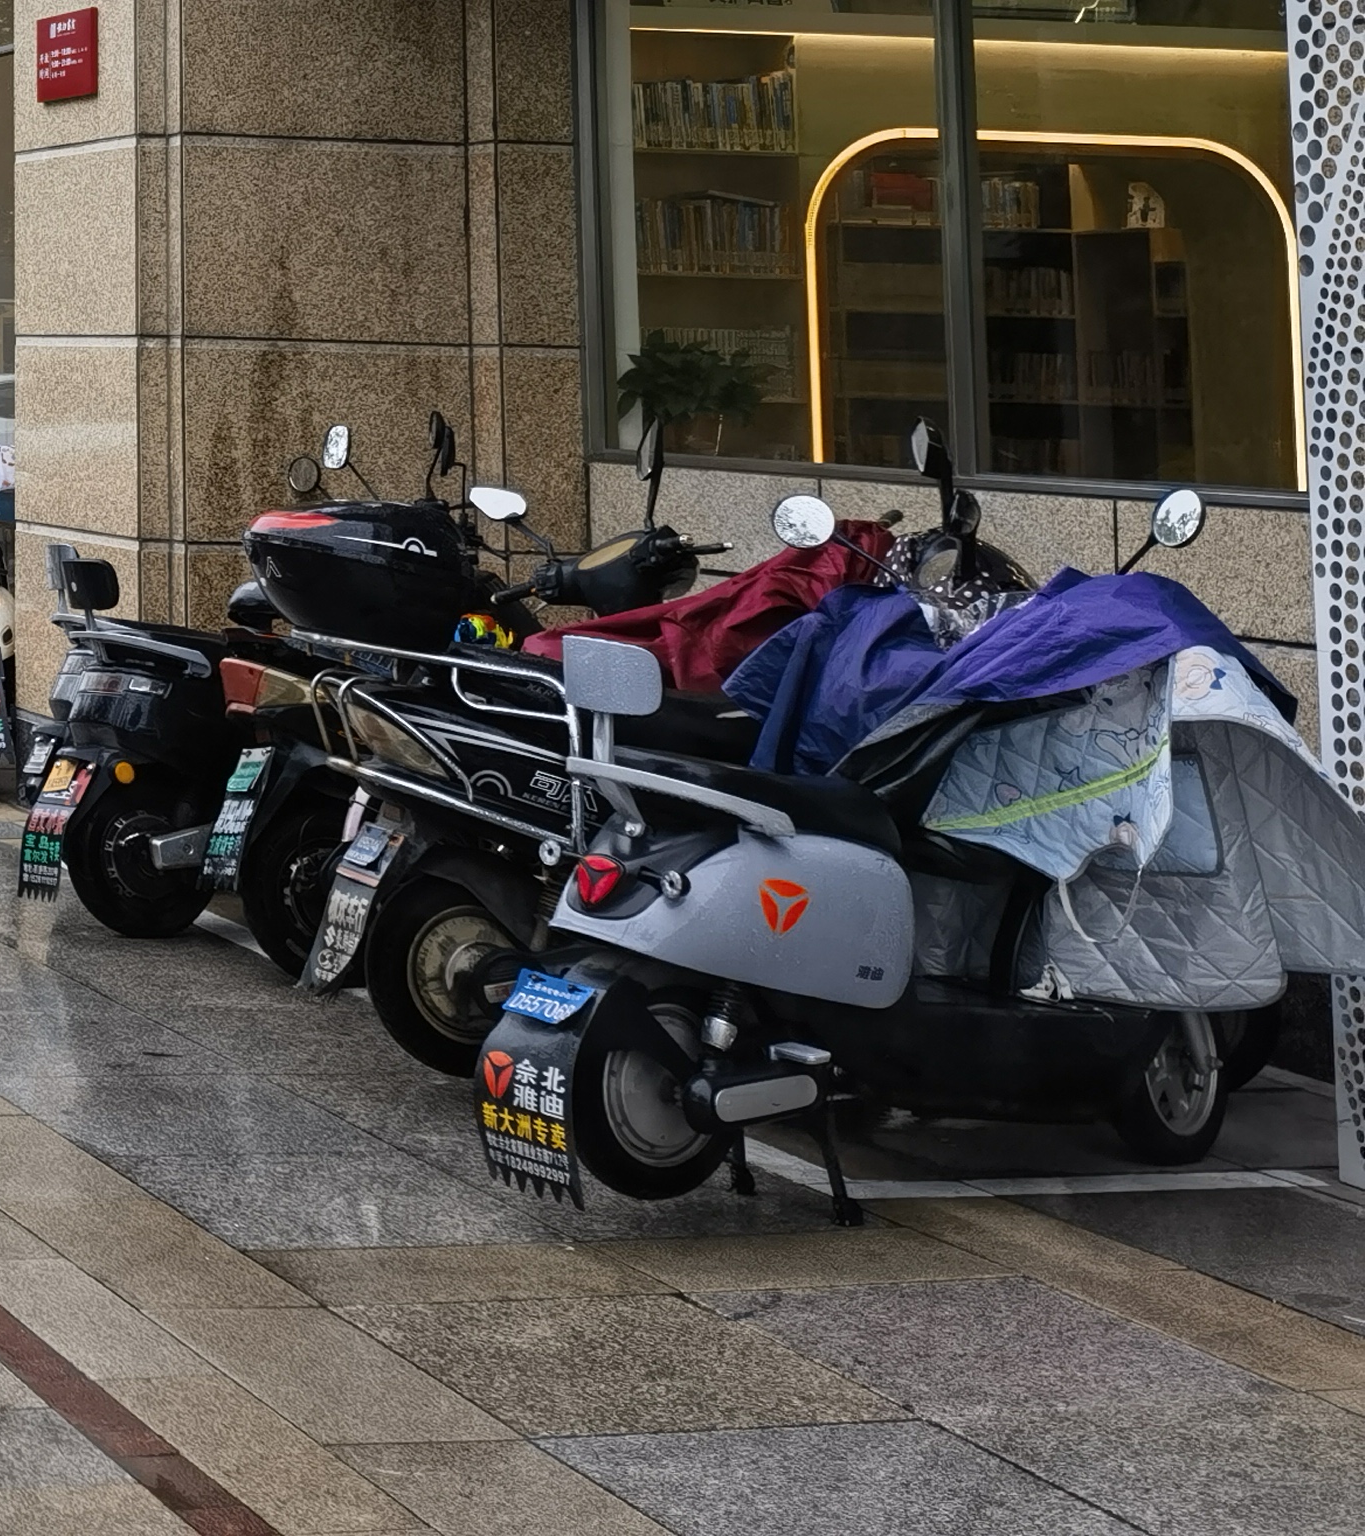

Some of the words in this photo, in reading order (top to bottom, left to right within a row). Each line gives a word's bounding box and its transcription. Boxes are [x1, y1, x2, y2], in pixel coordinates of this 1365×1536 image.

[514, 1058, 567, 1094] 佘北
[512, 1083, 566, 1121] 雅迪
[481, 1101, 568, 1153] 新大洲专卖
